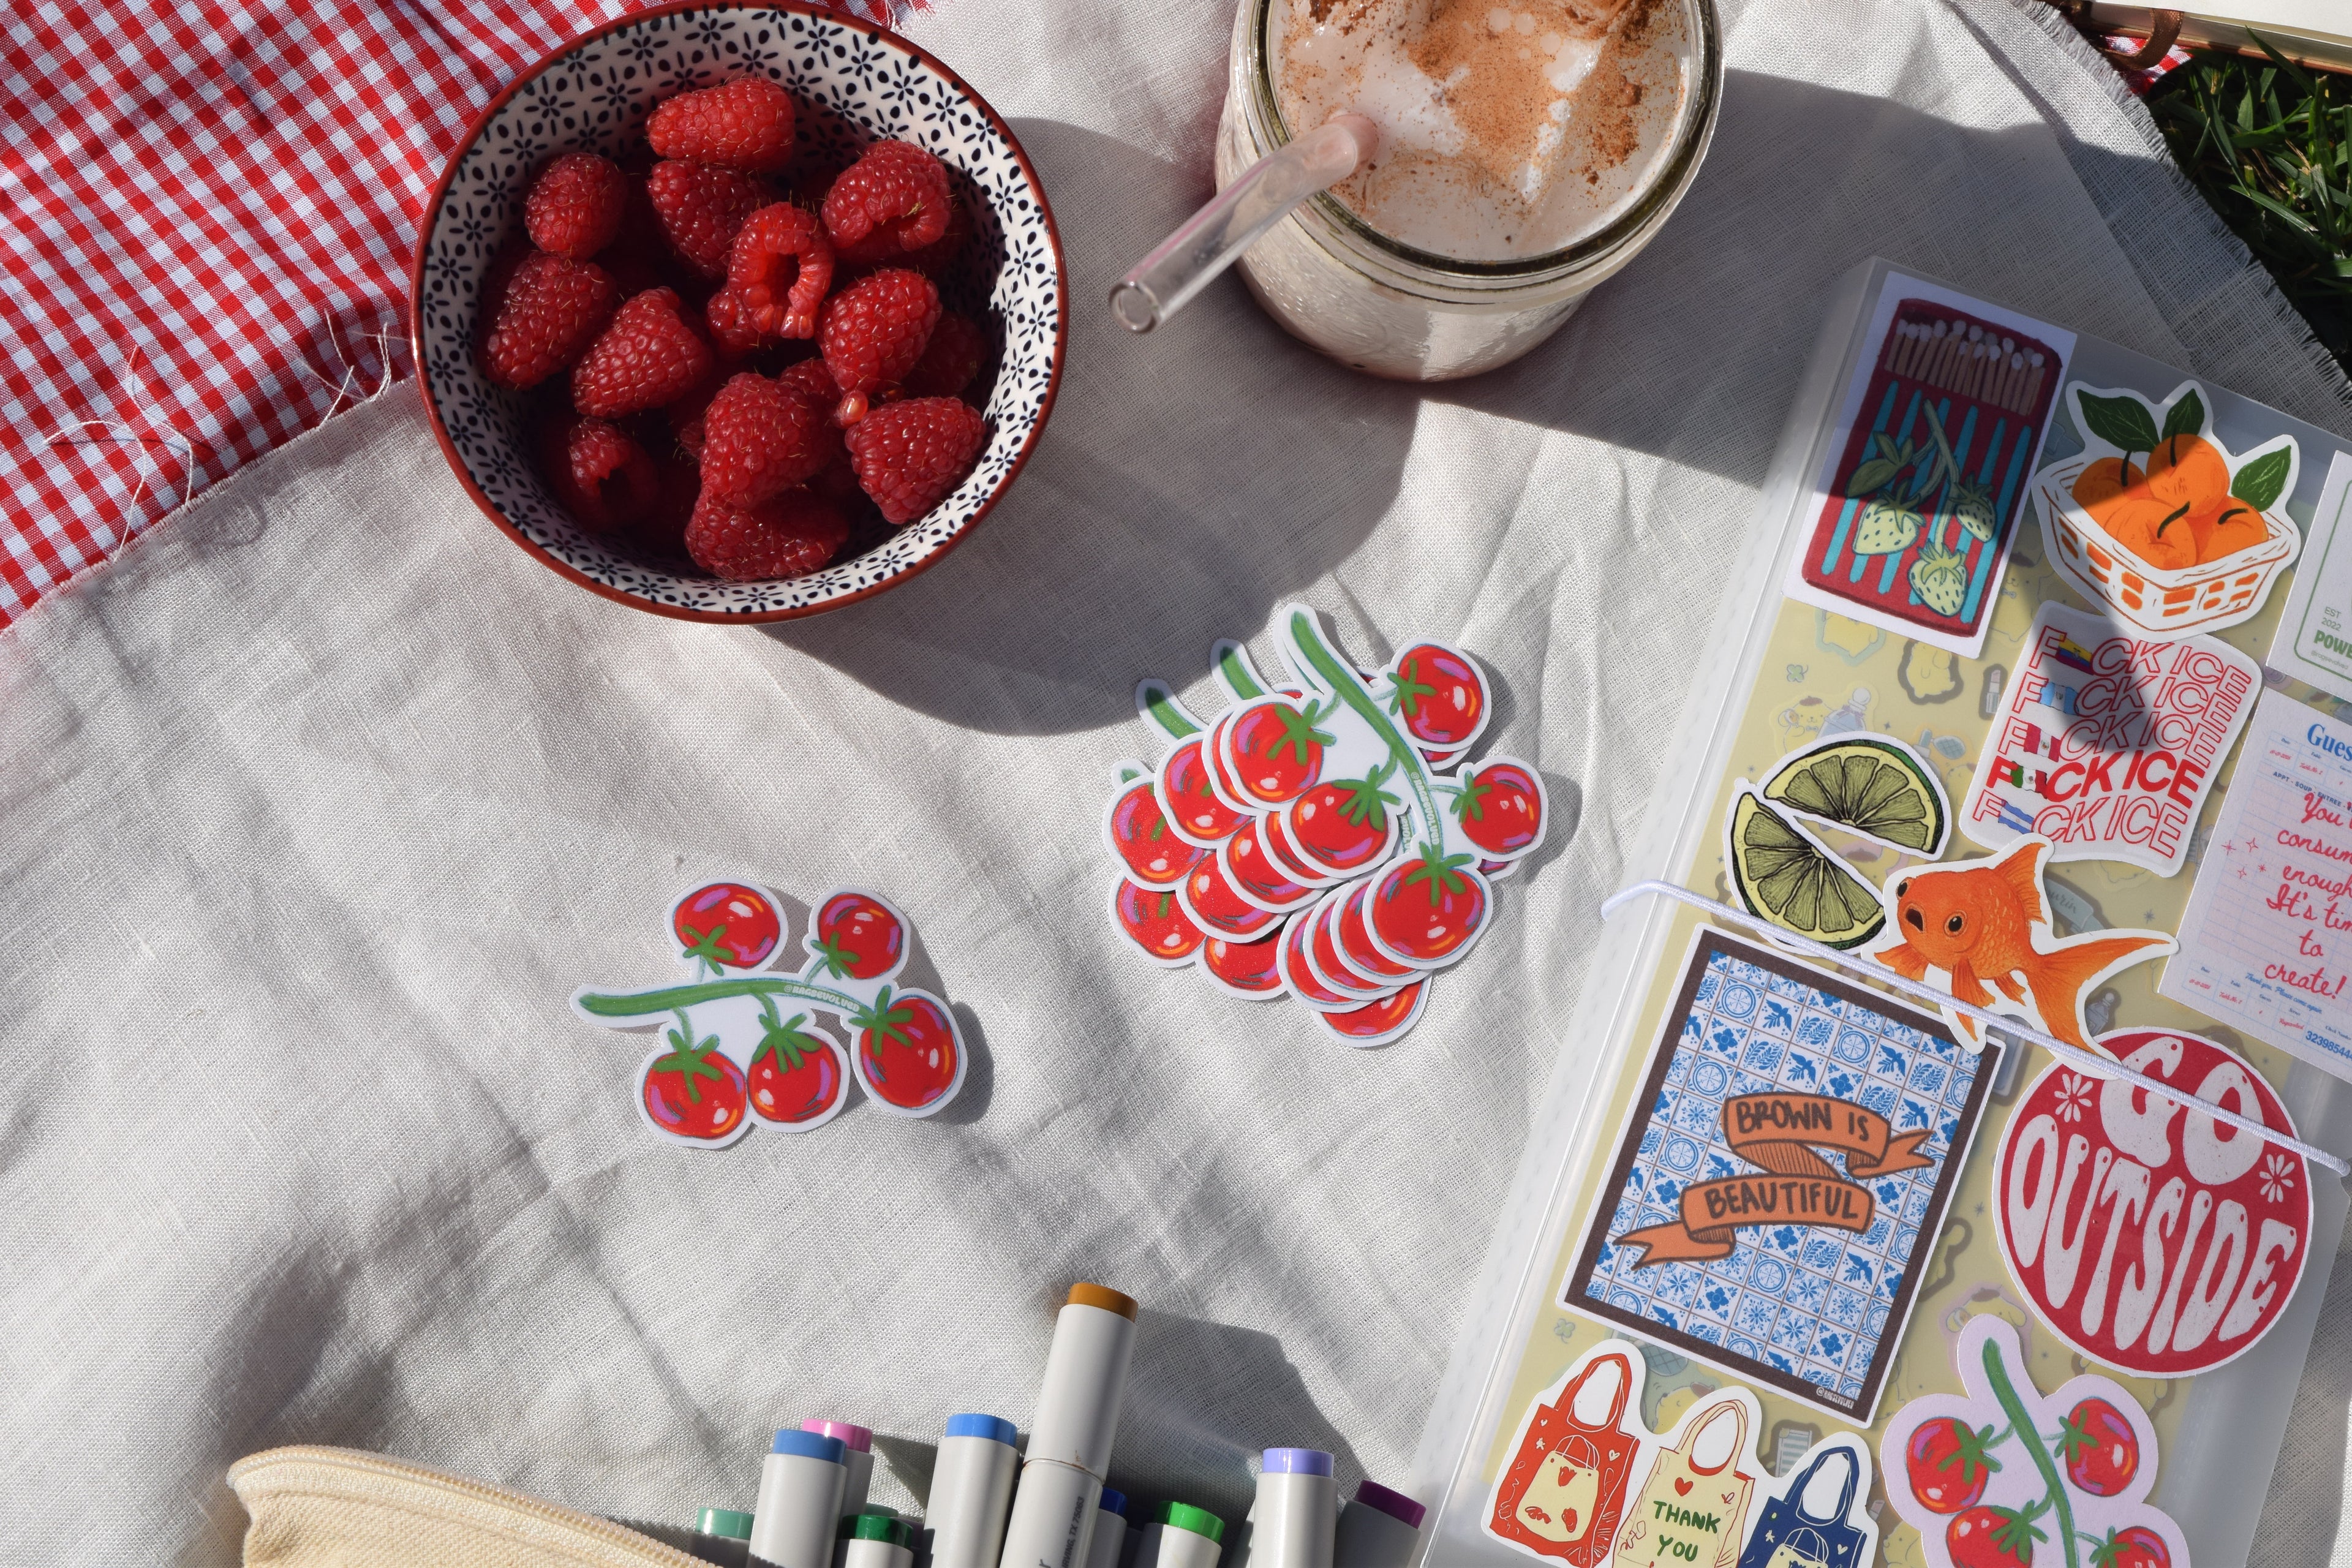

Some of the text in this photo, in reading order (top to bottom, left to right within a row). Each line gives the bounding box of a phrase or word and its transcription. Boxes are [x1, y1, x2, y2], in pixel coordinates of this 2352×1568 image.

[2321, 617, 2341, 631] 2022
[2324, 606, 2341, 619] EST
[2313, 630, 2352, 659] POWE
[2029, 625, 2252, 704] FCK ICE
[2012, 672, 2237, 733] FCK ICE
[1998, 711, 2222, 769] FCK ICE
[1986, 750, 2206, 809] FCK ICE
[2273, 771, 2342, 807] APPT SOUP ENTREE
[1972, 790, 2188, 859] FCK ICE
[2266, 883, 2318, 921] It's
[2299, 929, 2323, 957] to
[2264, 964, 2347, 1000] create!
[1736, 1099, 1869, 1142] BROWN IS
[2099, 1036, 2264, 1185] GO
[1704, 1182, 1858, 1219] BEAUTIFUL
[2008, 1114, 2297, 1354] OUTSIDE
[1072, 1496, 1084, 1523] 75063
[1653, 1500, 1721, 1534] THANK
[1069, 1524, 1078, 1536] TX
[1657, 1534, 1698, 1562] YOU
